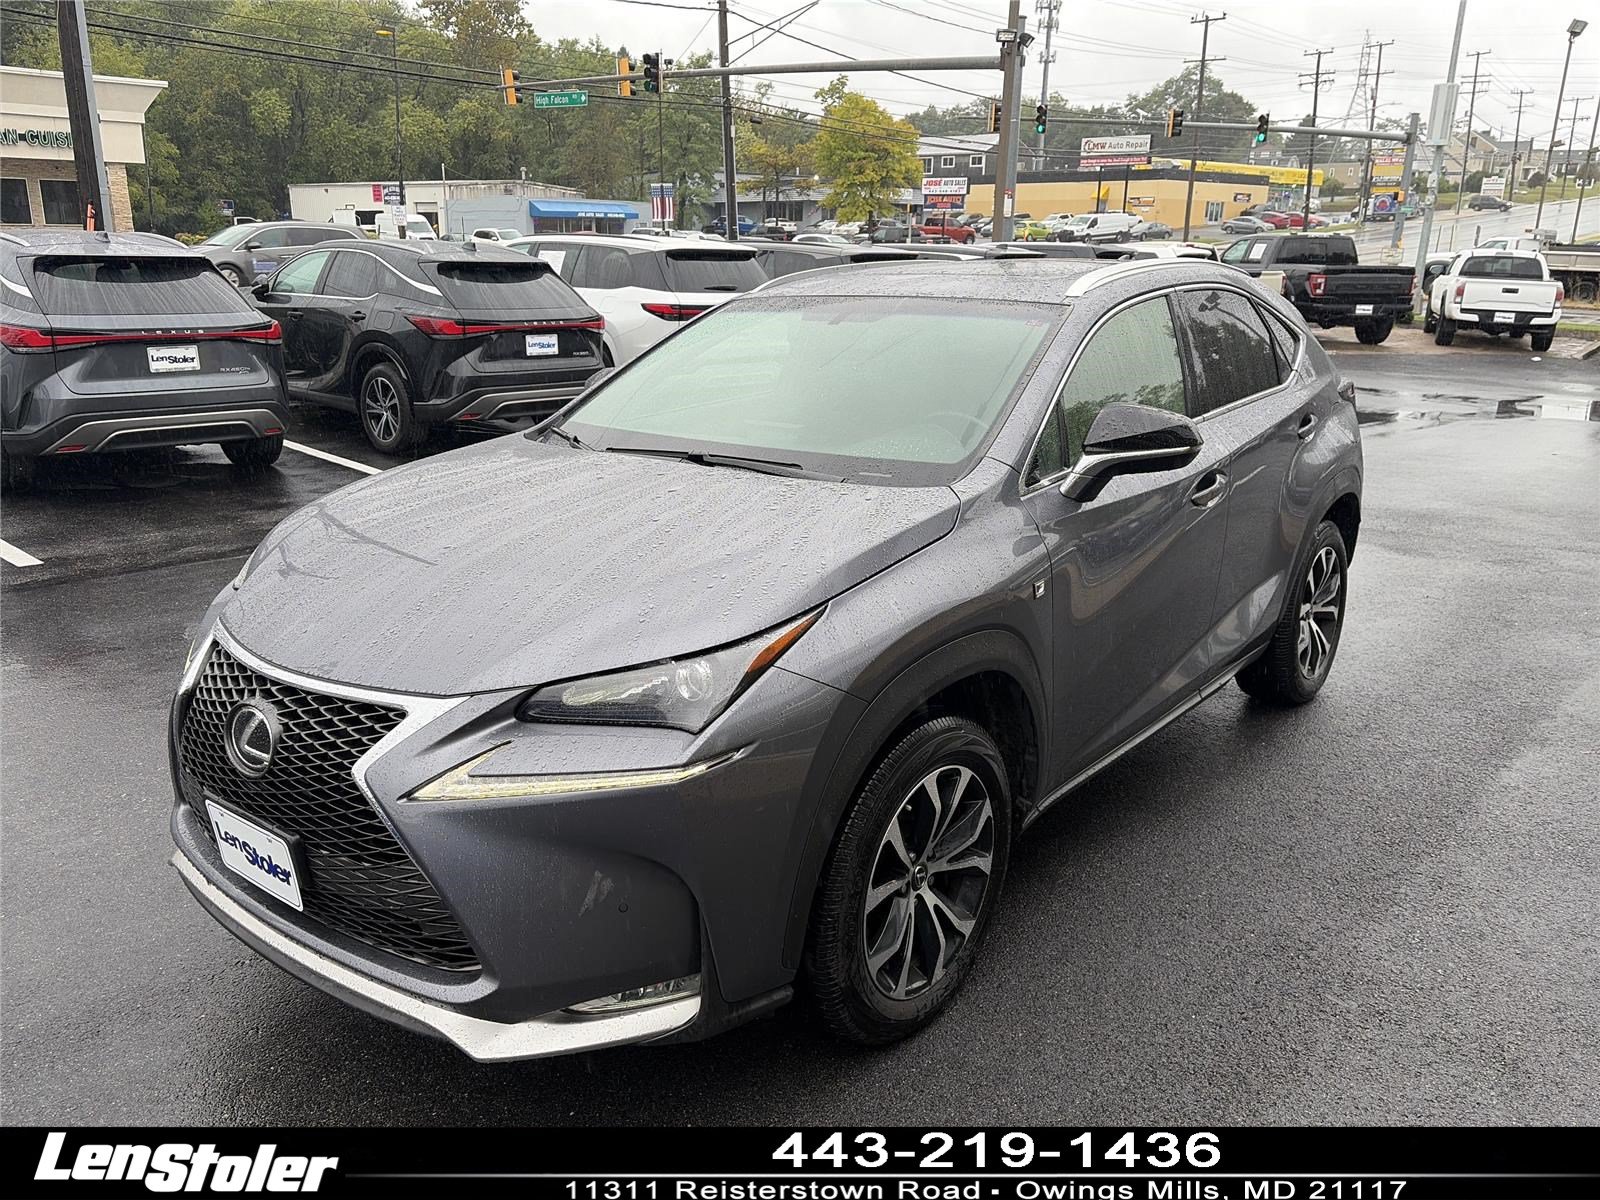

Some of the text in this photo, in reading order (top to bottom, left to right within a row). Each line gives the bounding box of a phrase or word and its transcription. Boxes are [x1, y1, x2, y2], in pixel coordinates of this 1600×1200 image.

[536, 95, 549, 106] High
[550, 95, 569, 104] Falcon
[1107, 141, 1125, 150] Auto
[1125, 139, 1149, 150] Repair
